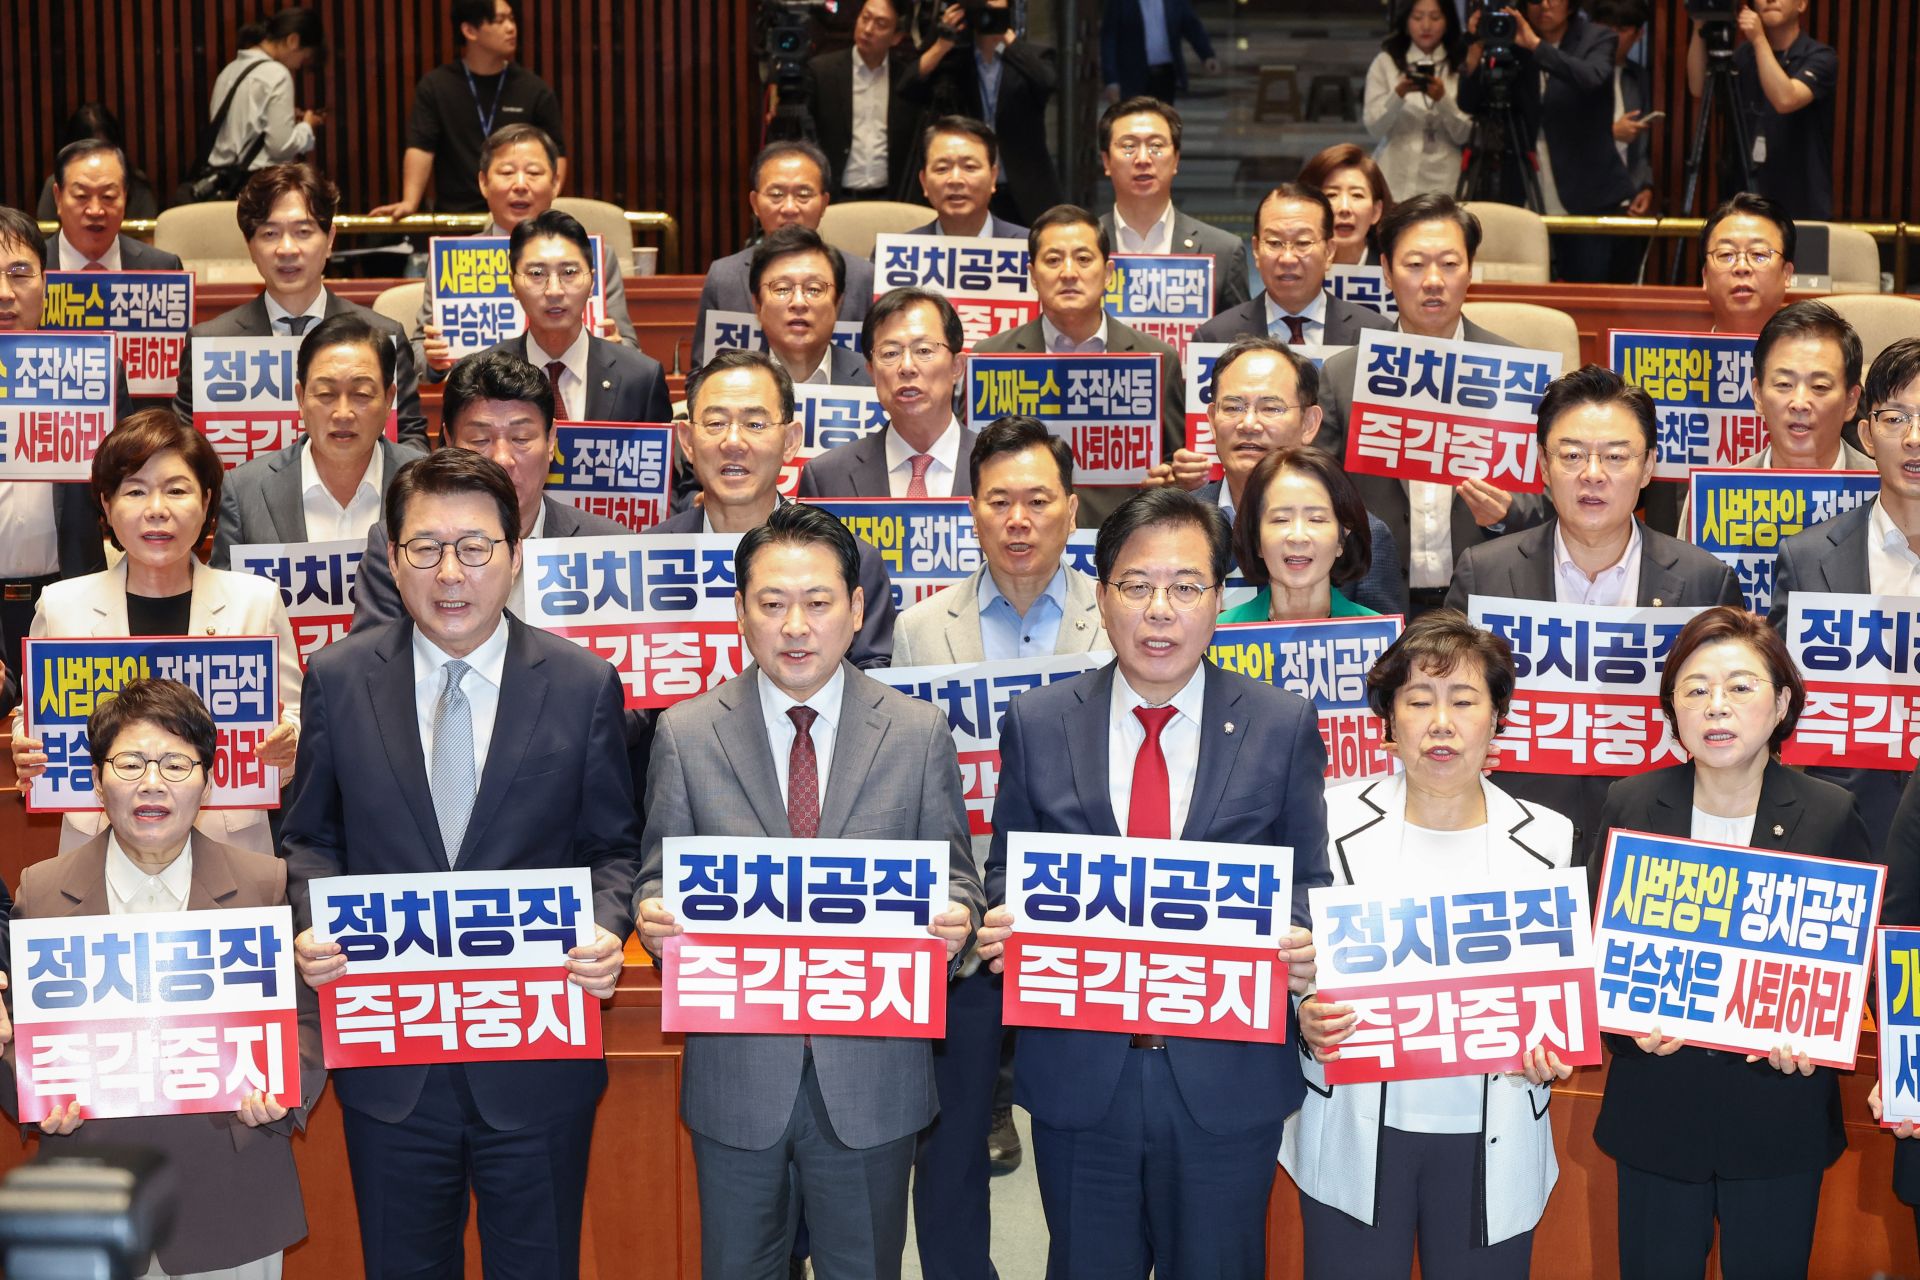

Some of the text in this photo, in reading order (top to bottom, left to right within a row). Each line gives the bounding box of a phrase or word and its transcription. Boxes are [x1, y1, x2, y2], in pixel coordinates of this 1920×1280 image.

[885, 246, 1030, 293] 정치공작
[1129, 268, 1205, 314] 정치공작
[110, 283, 186, 328] 조작선동
[442, 302, 516, 347] 부승찬은
[15, 347, 106, 400] 조작선동
[204, 350, 293, 402] 정치
[976, 369, 1061, 416] 가짜뉴스
[1067, 369, 1152, 416] 조작선동
[1367, 344, 1551, 414] 정치공작
[1623, 347, 1712, 402] 사법장악
[15, 412, 107, 463] 사퇴하라
[571, 438, 662, 488] 조작선동
[1072, 425, 1153, 470] 사퇴하라
[1358, 412, 1537, 483] 즉각중지
[910, 515, 987, 572] 정치공
[1703, 489, 1806, 547] 사법장악
[568, 632, 753, 697] 각중지
[1800, 609, 1920, 673] 정치
[1796, 691, 1920, 758] 즉각
[679, 854, 937, 926] 정치공작
[1023, 852, 1280, 935] 정치공작
[1612, 855, 1867, 956] 사법장악 정치공작
[327, 886, 581, 961] 정치공작
[1326, 886, 1577, 974] 정치공작
[27, 925, 281, 1009] 정치공작
[677, 945, 931, 1024] 즉각중지
[1019, 944, 1272, 1029] 즉각중지
[1600, 938, 1852, 1042] 부승찬은 사퇴하라
[336, 980, 586, 1053] 즉각중지
[1335, 981, 1584, 1068] 즉각중지
[32, 1023, 284, 1106] 즉각중지
